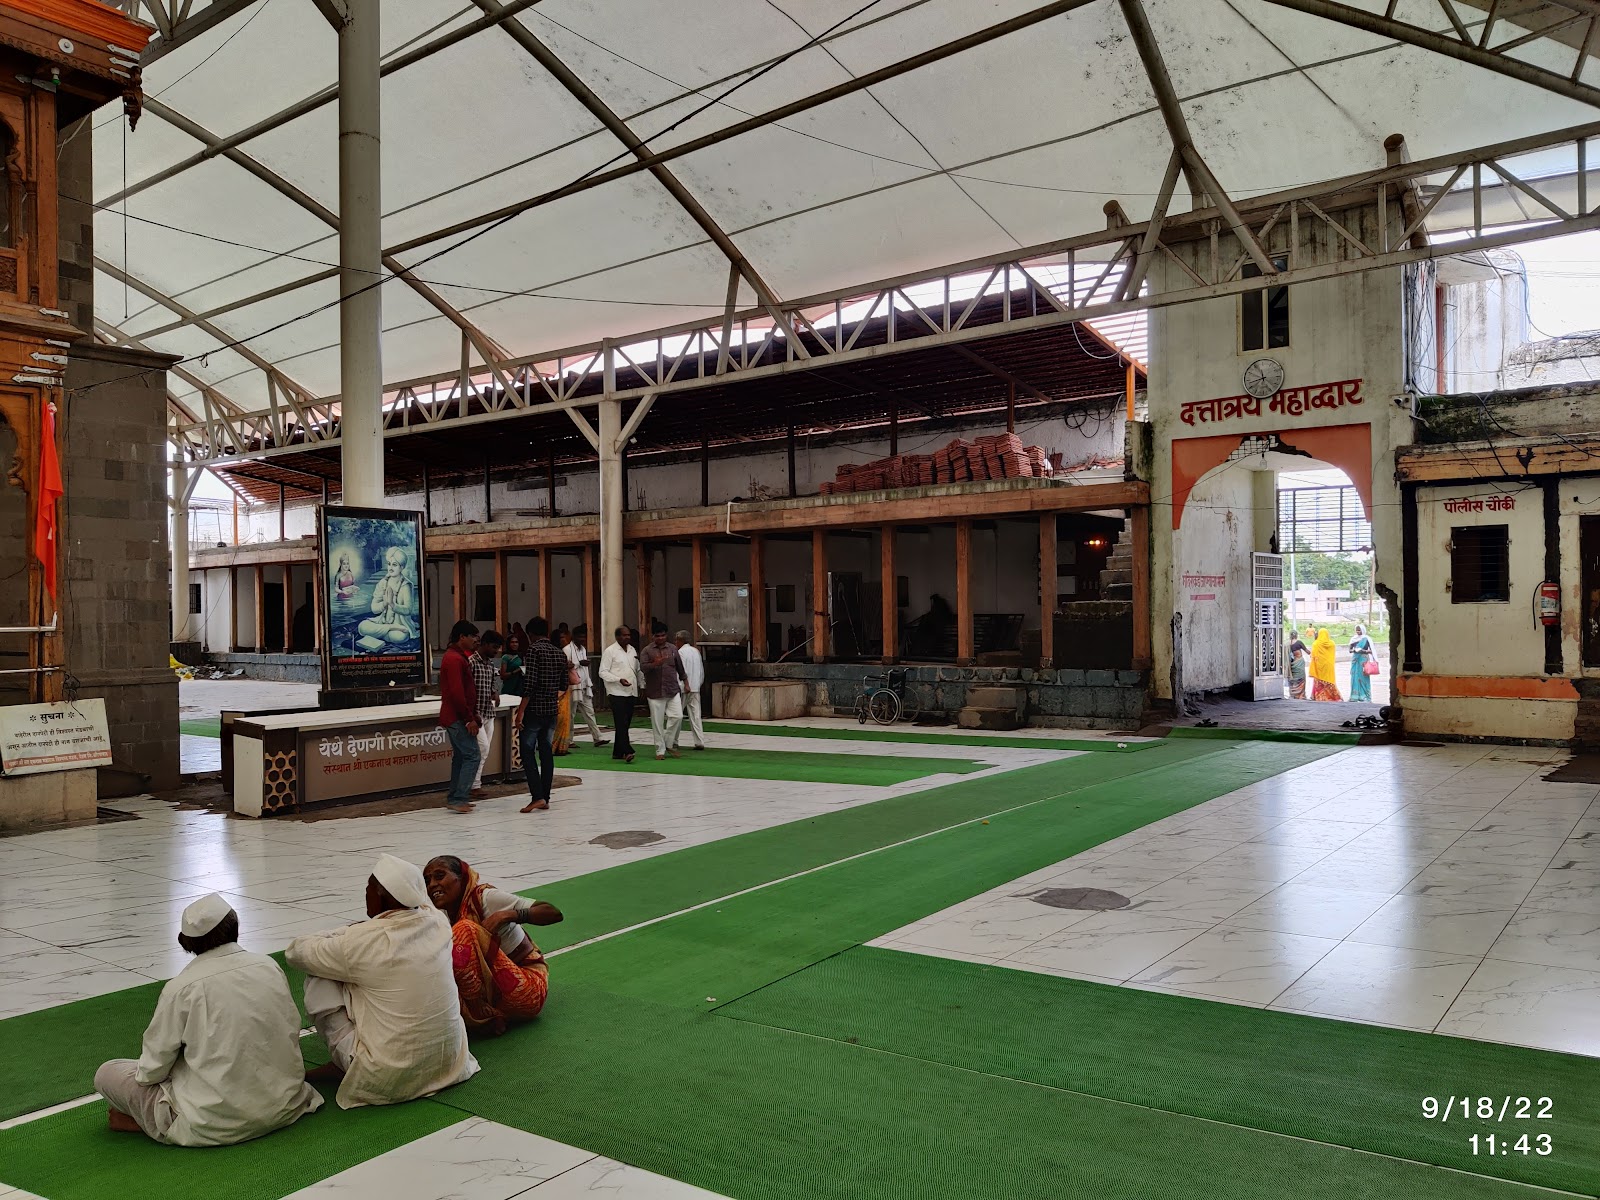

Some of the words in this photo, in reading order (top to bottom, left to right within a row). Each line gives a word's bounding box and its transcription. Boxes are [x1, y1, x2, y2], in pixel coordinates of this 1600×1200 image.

[1443, 496, 1484, 514] पोलीस
[39, 712, 65, 725] सुचना
[318, 736, 344, 758] येथे
[347, 731, 386, 758] देणगी
[392, 754, 419, 766] महाराज
